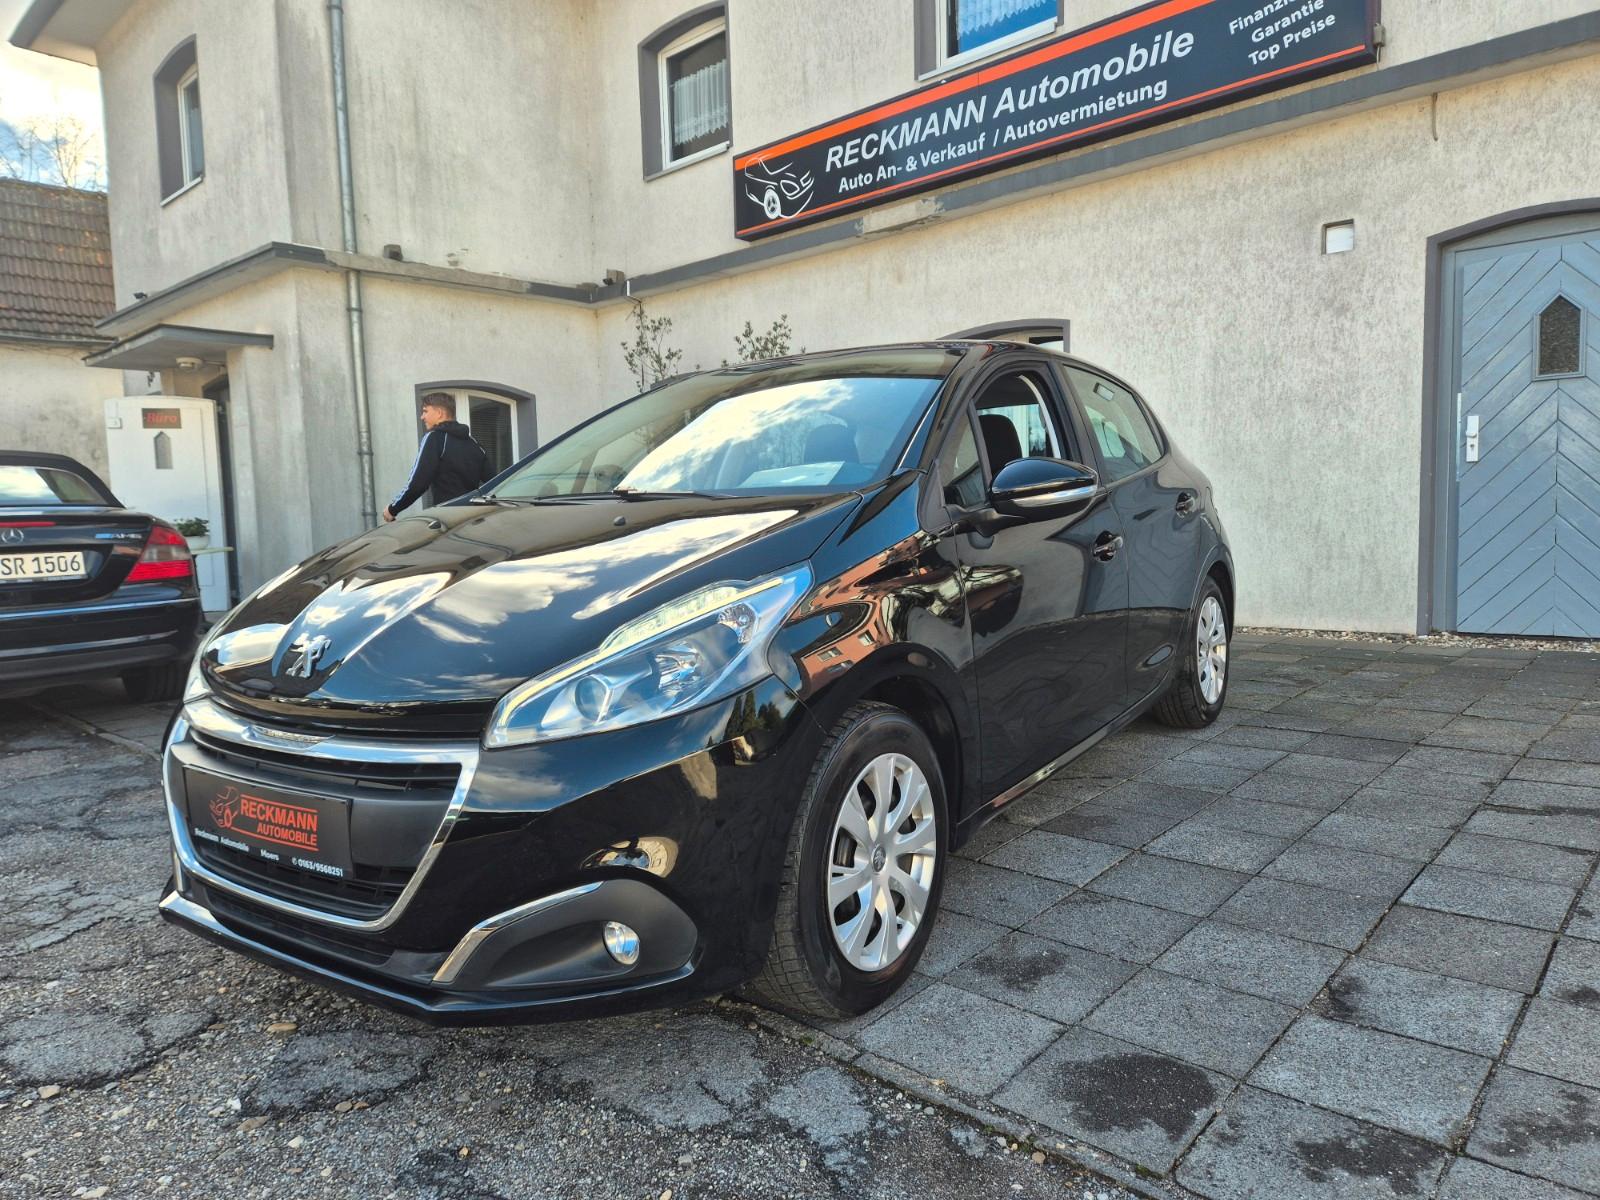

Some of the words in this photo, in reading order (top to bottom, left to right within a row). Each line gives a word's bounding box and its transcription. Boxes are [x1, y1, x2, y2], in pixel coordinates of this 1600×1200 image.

[1228, 0, 1296, 35] Finanz
[1251, 0, 1324, 43] Garantie
[1248, 43, 1280, 65] Top
[1282, 14, 1336, 49] Preise
[825, 96, 987, 173] RECKMANN
[993, 30, 1195, 119] Automobile
[838, 173, 873, 193] Auto
[876, 164, 902, 182] An-
[905, 156, 917, 172] &
[920, 133, 986, 166] Verkauf
[1003, 79, 1168, 143] Autovermietung
[0, 557, 26, 576] SR
[32, 554, 81, 574] 1506
[240, 799, 318, 832] RECKMANN
[256, 823, 318, 846] AUTOMOBILE
